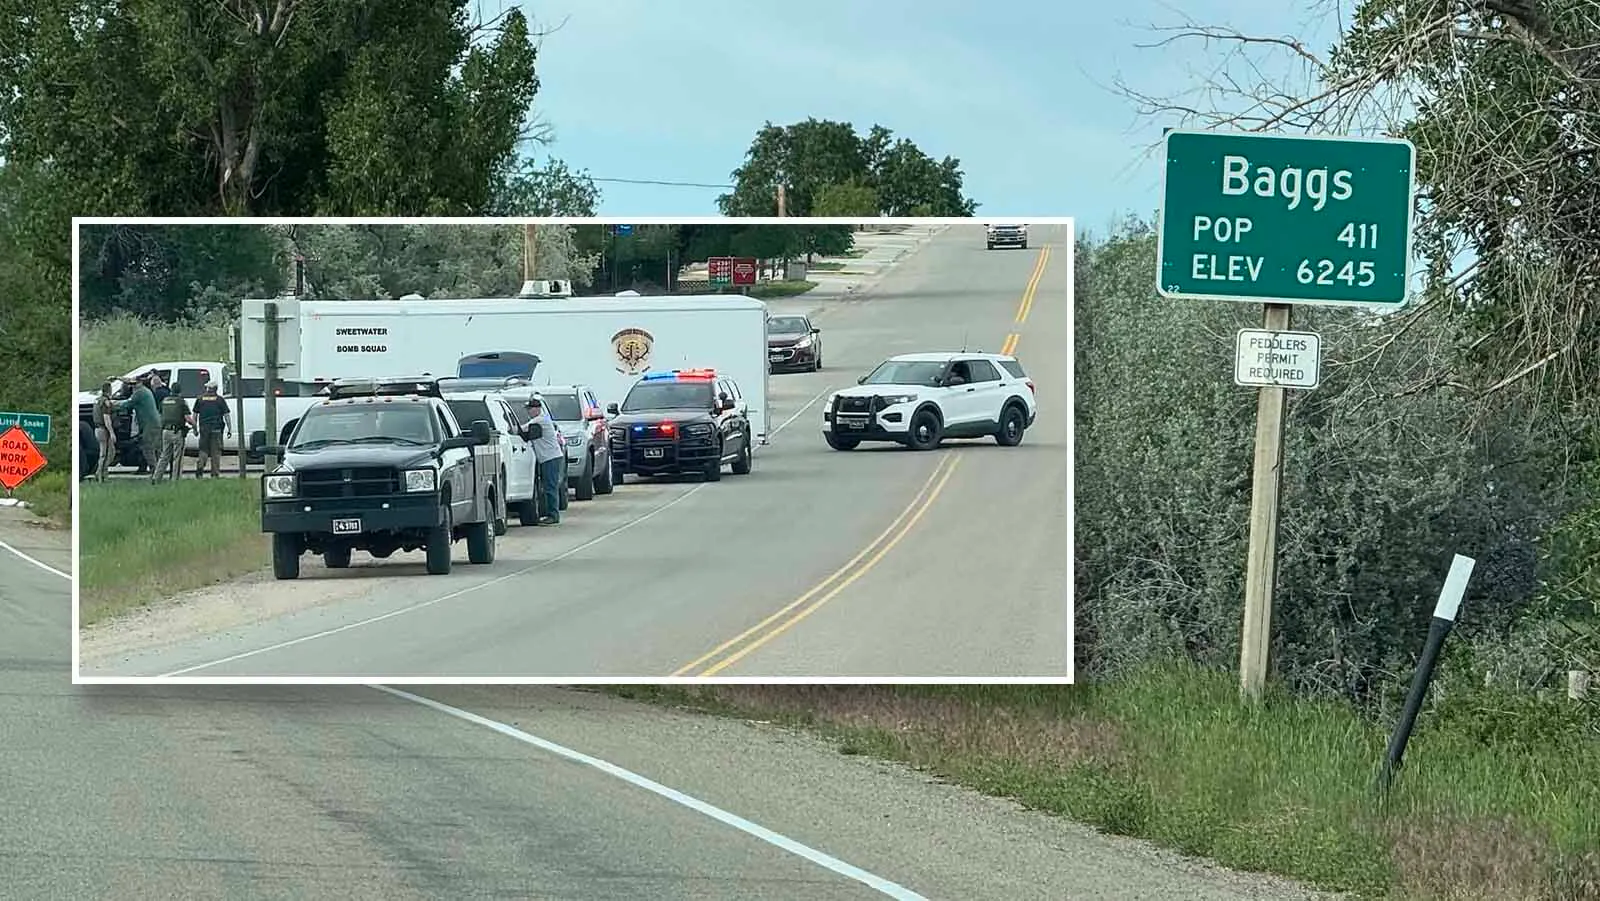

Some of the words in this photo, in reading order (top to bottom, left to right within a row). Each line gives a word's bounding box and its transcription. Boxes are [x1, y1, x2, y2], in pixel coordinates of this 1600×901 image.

[1222, 155, 1353, 212] Baggs
[1193, 215, 1253, 243] POP
[1337, 222, 1378, 249] 411
[1191, 253, 1265, 282] ELEV
[1296, 258, 1376, 287] 6245
[335, 327, 389, 336] SWEETWATER
[336, 344, 359, 353] BOMB
[360, 344, 387, 353] SQUAD
[1250, 337, 1307, 351] PEDDLERS
[1257, 352, 1299, 365] PERMIT
[1249, 367, 1304, 380] REQUIRED
[23, 419, 45, 428] Snake
[2, 439, 28, 451] ROAD
[0, 452, 27, 463] WORK
